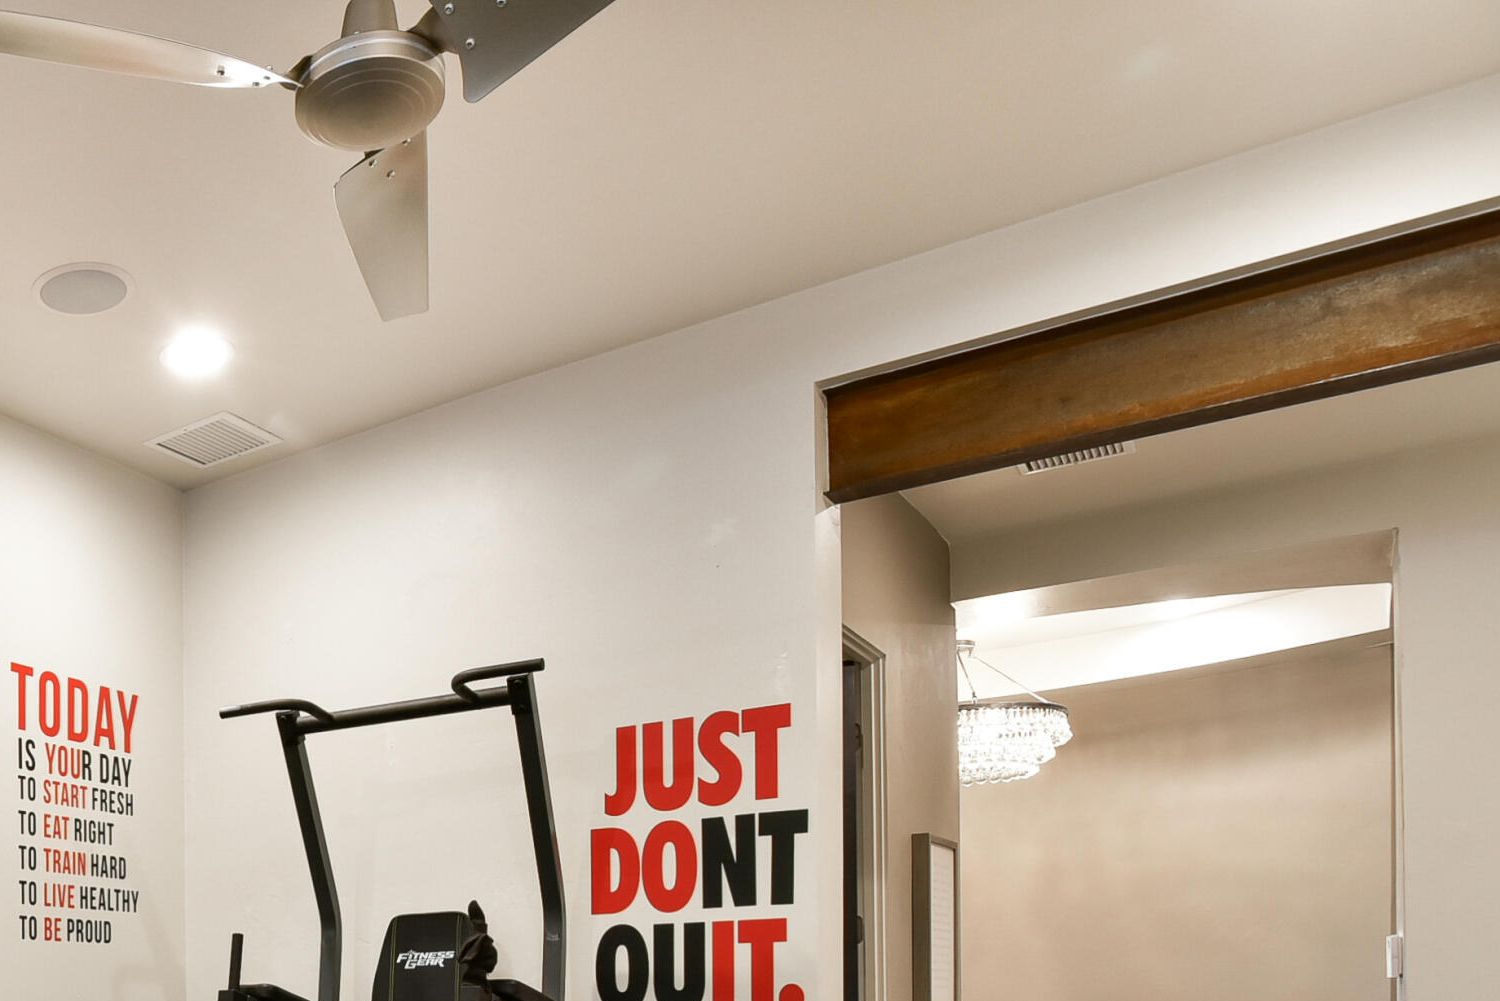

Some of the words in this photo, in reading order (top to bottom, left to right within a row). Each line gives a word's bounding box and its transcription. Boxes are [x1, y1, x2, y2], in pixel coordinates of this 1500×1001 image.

[10, 661, 139, 754] TODAY
[18, 737, 35, 771] IS
[45, 742, 92, 781] YOUR
[100, 753, 132, 788] DAY
[604, 703, 791, 816] JUST
[18, 775, 36, 801] TO
[43, 779, 88, 809] START
[91, 787, 134, 816] FRESH
[18, 810, 36, 836] TO
[44, 813, 70, 840] EAT
[74, 818, 114, 846] RIGHT
[18, 845, 37, 871] TO
[43, 848, 87, 876] TRAIN
[90, 853, 127, 880] HARD
[590, 808, 808, 915] DONT
[19, 880, 37, 906] TO
[44, 882, 75, 909] LIVE
[79, 886, 139, 913] HEALTHY
[19, 915, 37, 940] TO
[44, 917, 62, 942] BE
[67, 918, 112, 944] PROUD
[396, 950, 455, 963] FITNESS
[404, 958, 445, 969] GEAR
